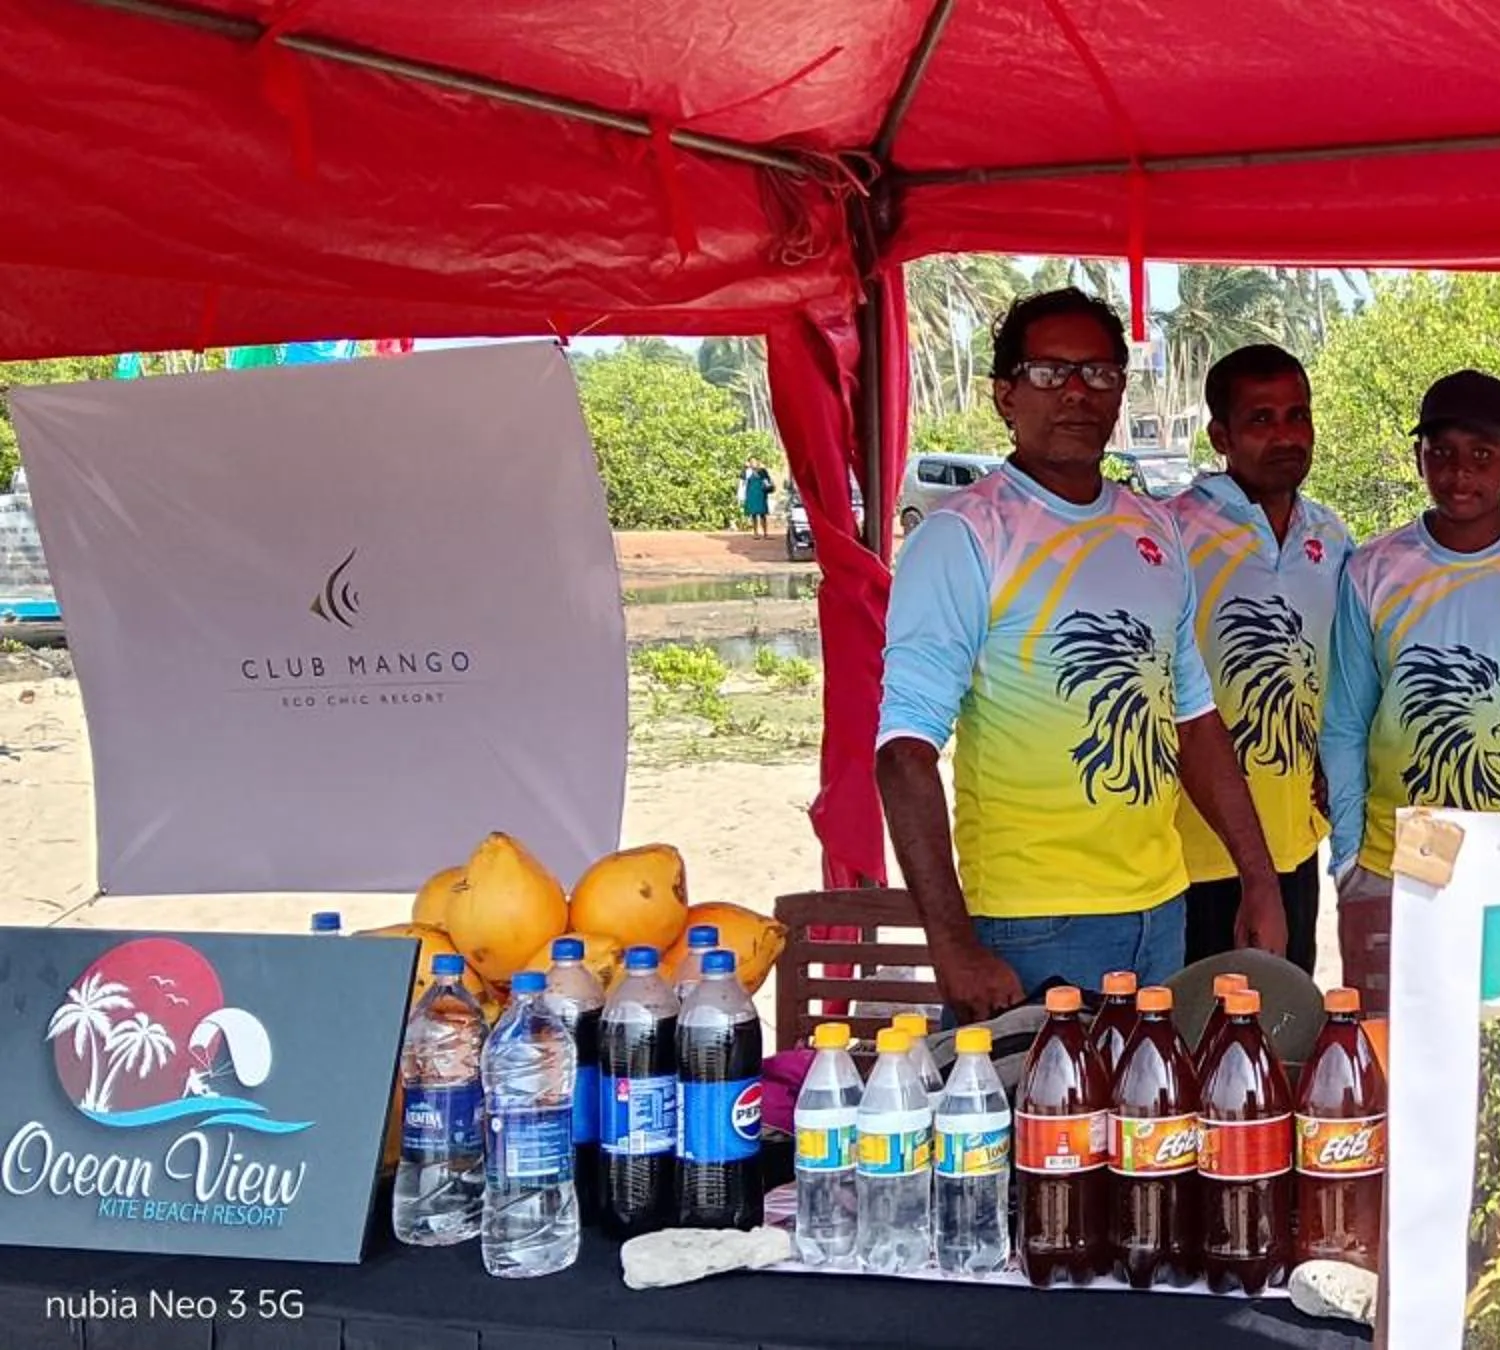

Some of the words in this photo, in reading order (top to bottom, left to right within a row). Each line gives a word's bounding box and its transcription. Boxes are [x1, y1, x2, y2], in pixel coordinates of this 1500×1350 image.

[241, 656, 326, 679] CLUB
[347, 651, 470, 675] MANGO
[282, 696, 317, 708] ECO
[327, 695, 370, 706] CHIC
[380, 692, 445, 705] RESORT
[1319, 1128, 1372, 1163] EGB
[2, 1121, 152, 1197] Ocean
[165, 1131, 306, 1207] View
[99, 1198, 138, 1219] KITE
[143, 1201, 207, 1222] BEACH
[211, 1205, 288, 1226] RESORT
